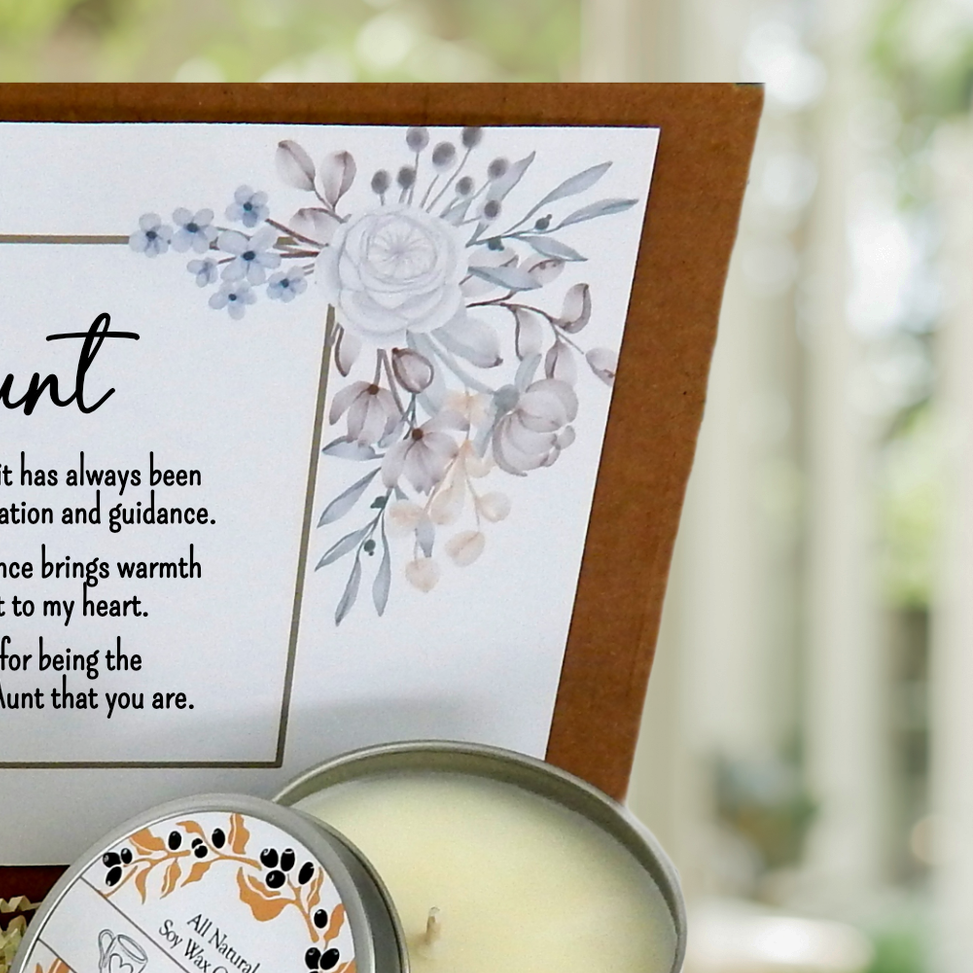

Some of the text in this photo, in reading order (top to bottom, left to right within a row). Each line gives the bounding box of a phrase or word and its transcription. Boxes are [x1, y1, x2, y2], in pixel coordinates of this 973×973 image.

[21, 451, 58, 486] has
[66, 451, 141, 495] always
[150, 451, 201, 486] been
[62, 490, 101, 524] and
[109, 490, 215, 533] guidance.
[42, 544, 109, 587] brings
[117, 544, 201, 578] warmth
[12, 596, 34, 617] to
[44, 601, 74, 626] my
[83, 582, 148, 617] heart.
[0, 636, 32, 671] for
[39, 636, 99, 680] being
[105, 636, 142, 671] the
[51, 674, 98, 709] that
[105, 692, 144, 719] you
[152, 692, 194, 709] are.
[159, 919, 182, 949] Soy
[183, 939, 210, 973] Wax
[187, 914, 212, 937] All
